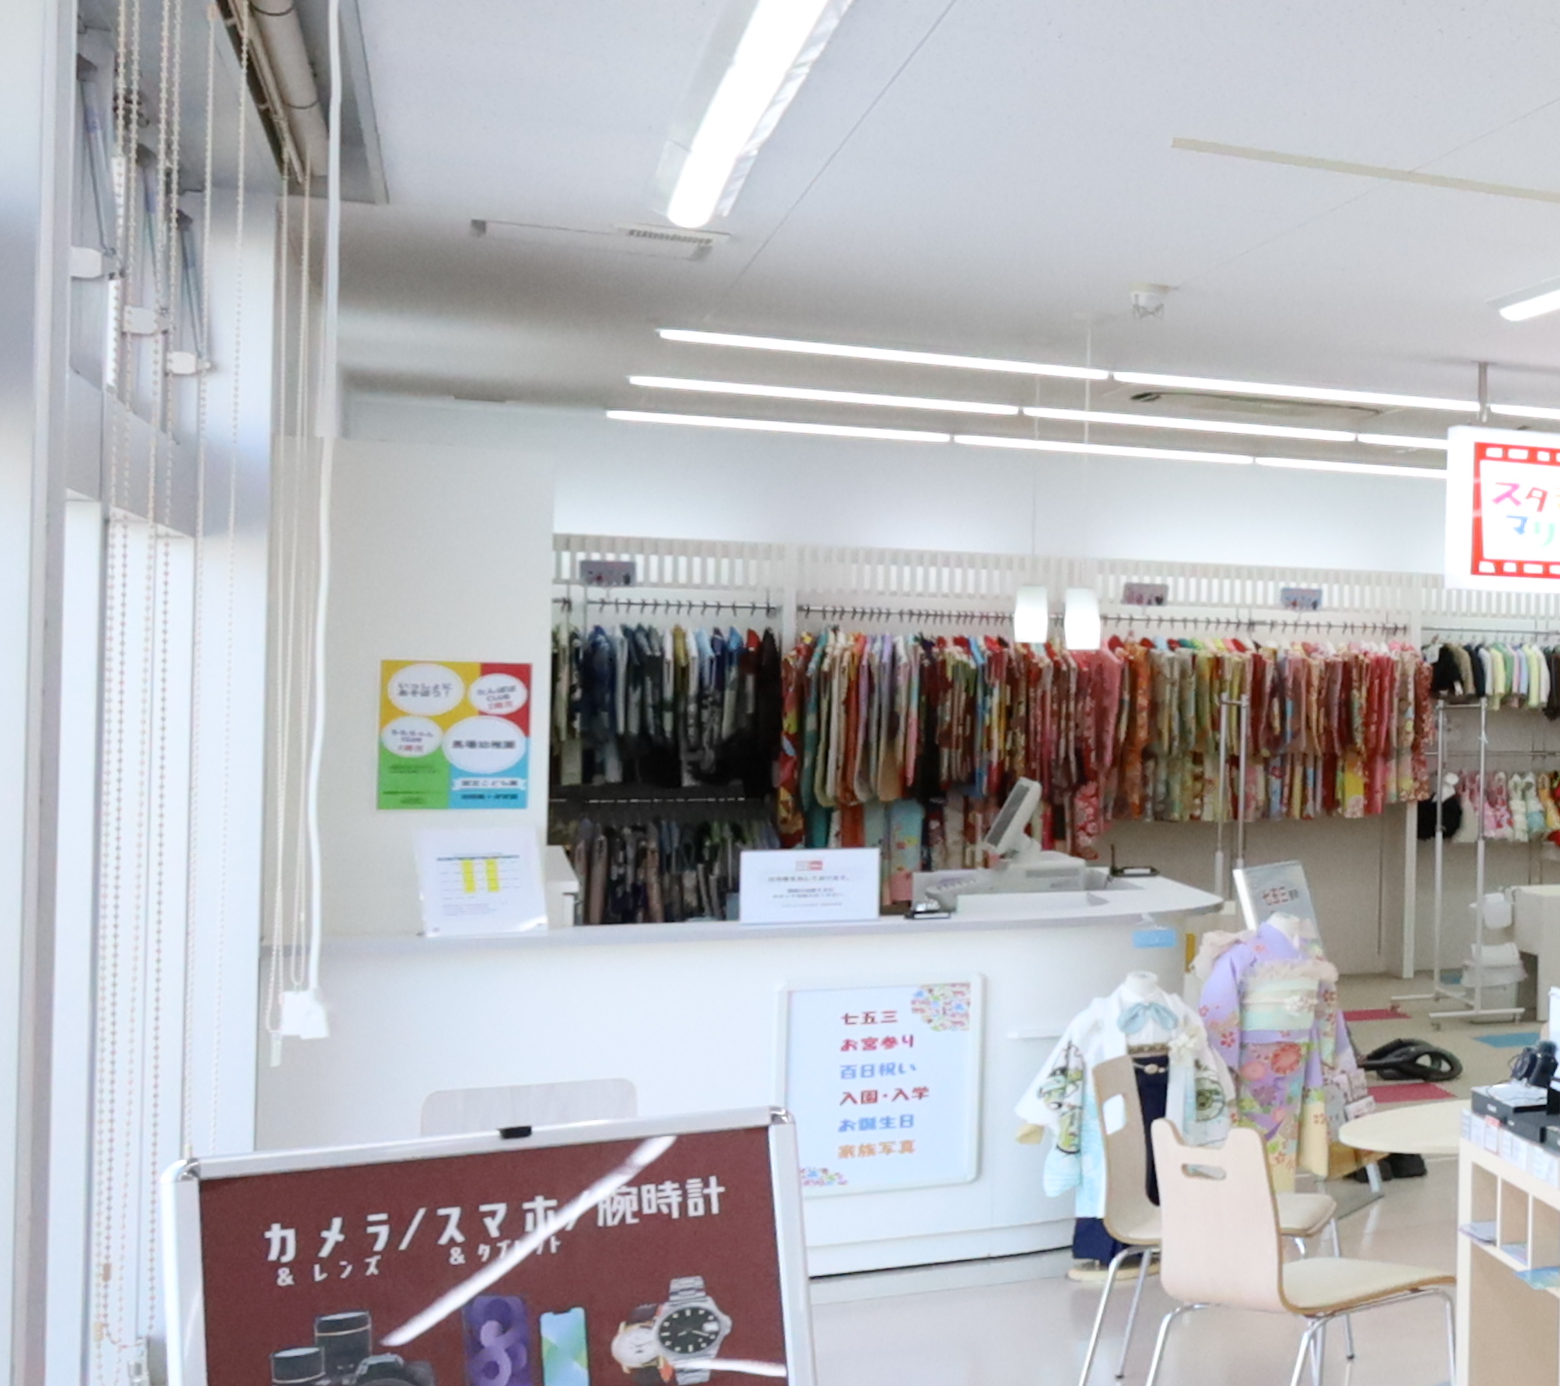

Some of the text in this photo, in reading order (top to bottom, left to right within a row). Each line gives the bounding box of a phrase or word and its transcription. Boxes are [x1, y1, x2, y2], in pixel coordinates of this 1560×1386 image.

[841, 1010, 898, 1026] 七五三
[840, 1034, 914, 1052] お宮参り
[840, 1062, 917, 1080] 百日祝い
[839, 1086, 930, 1106] 入園・入学
[838, 1114, 914, 1133] お誕生日
[838, 1139, 916, 1159] 家族写真
